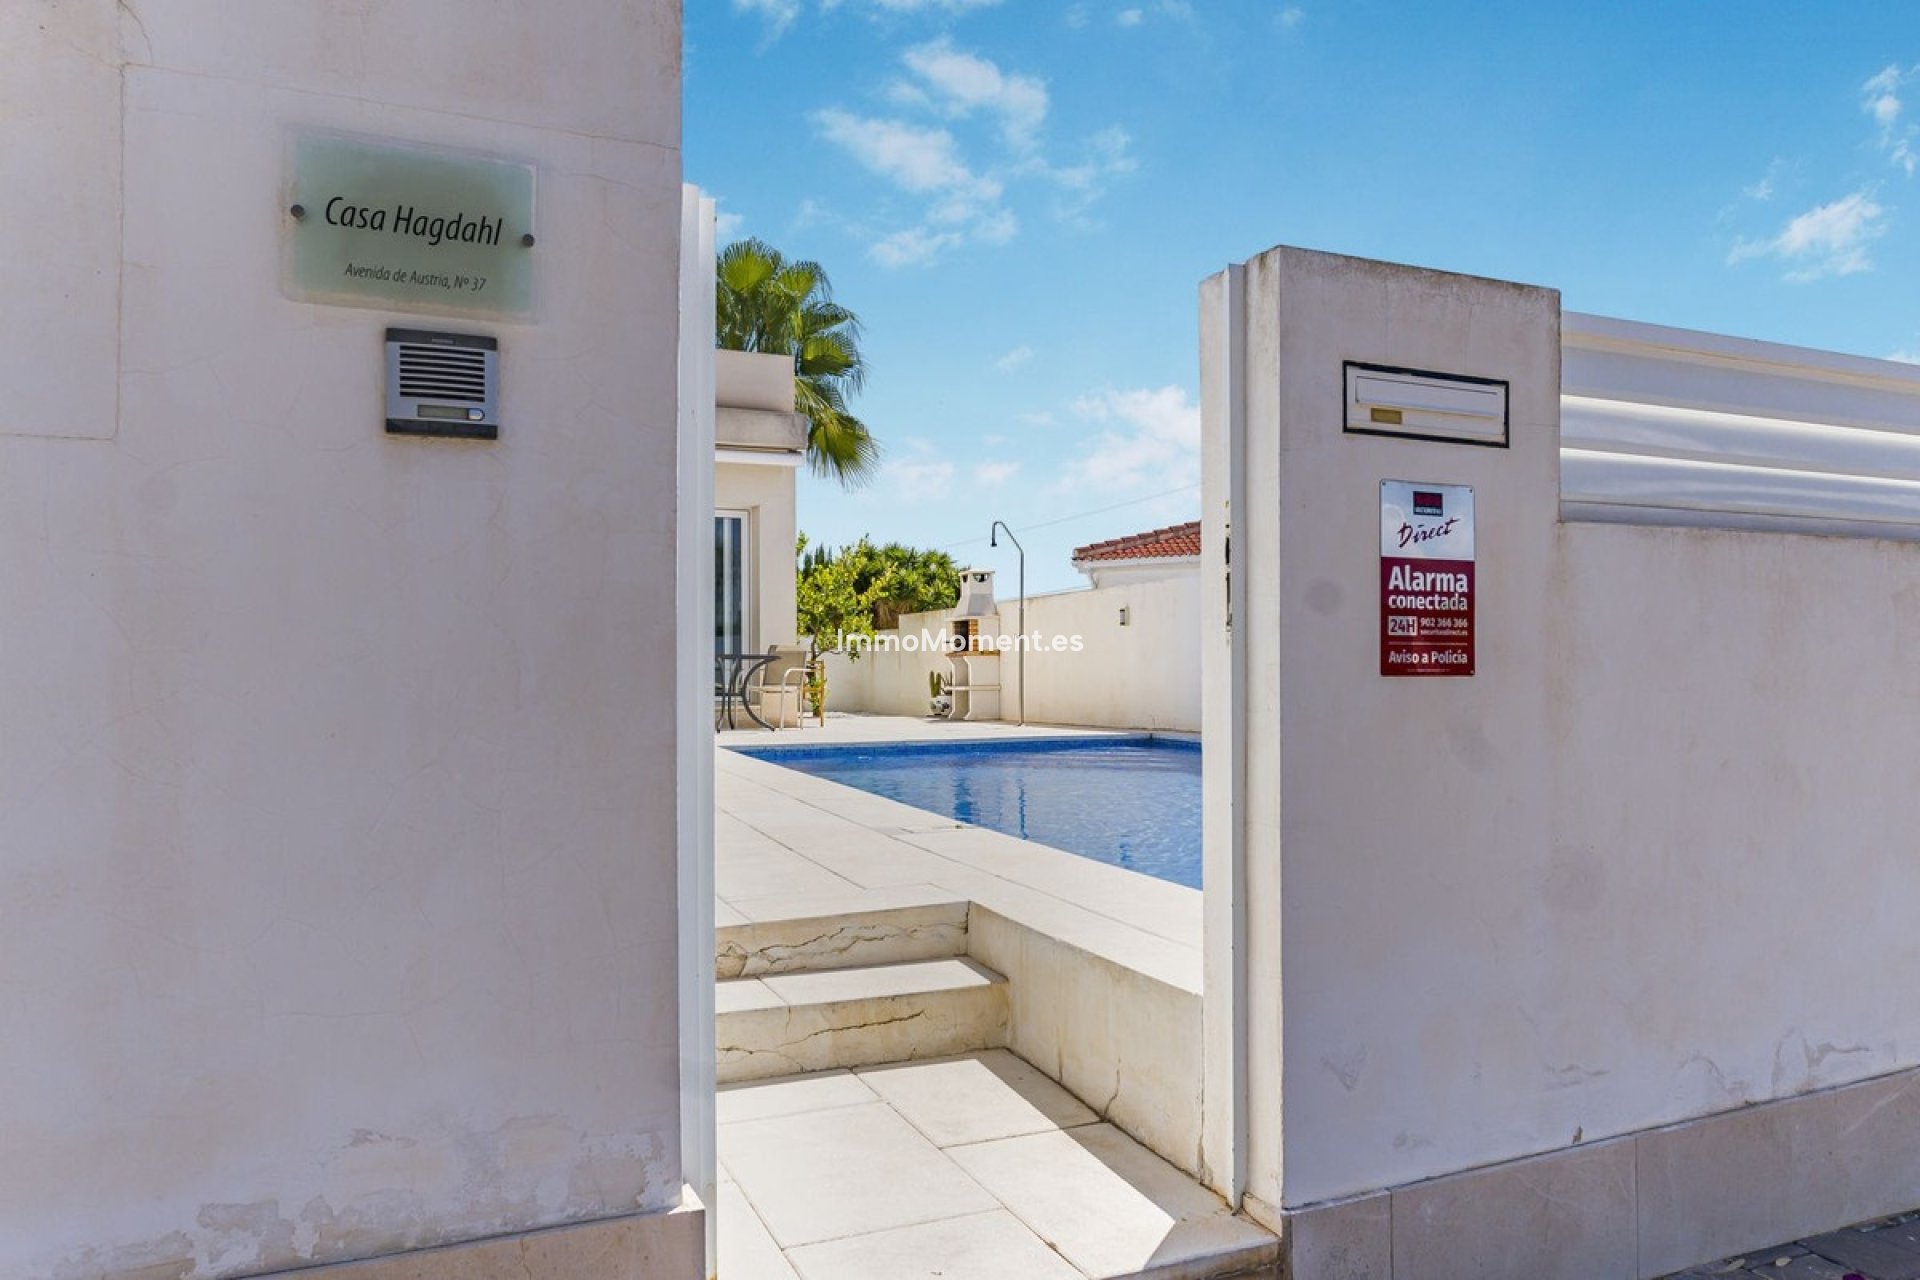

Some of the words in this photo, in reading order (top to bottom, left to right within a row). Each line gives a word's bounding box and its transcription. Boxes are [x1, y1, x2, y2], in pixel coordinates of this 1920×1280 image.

[325, 196, 386, 231] Casa
[392, 205, 503, 246] Hagdahl
[344, 263, 390, 281] Avenida
[393, 268, 407, 283] de
[409, 270, 451, 290] Austria,
[471, 277, 487, 291] 37
[1397, 516, 1460, 548] Direct
[1388, 564, 1468, 592] Alarma
[1388, 593, 1468, 611] conectada
[1390, 618, 1415, 633] 24H
[1420, 617, 1436, 628] 902
[1388, 649, 1419, 664] Aviso
[1421, 653, 1429, 664] a
[1431, 649, 1468, 664] Policía
